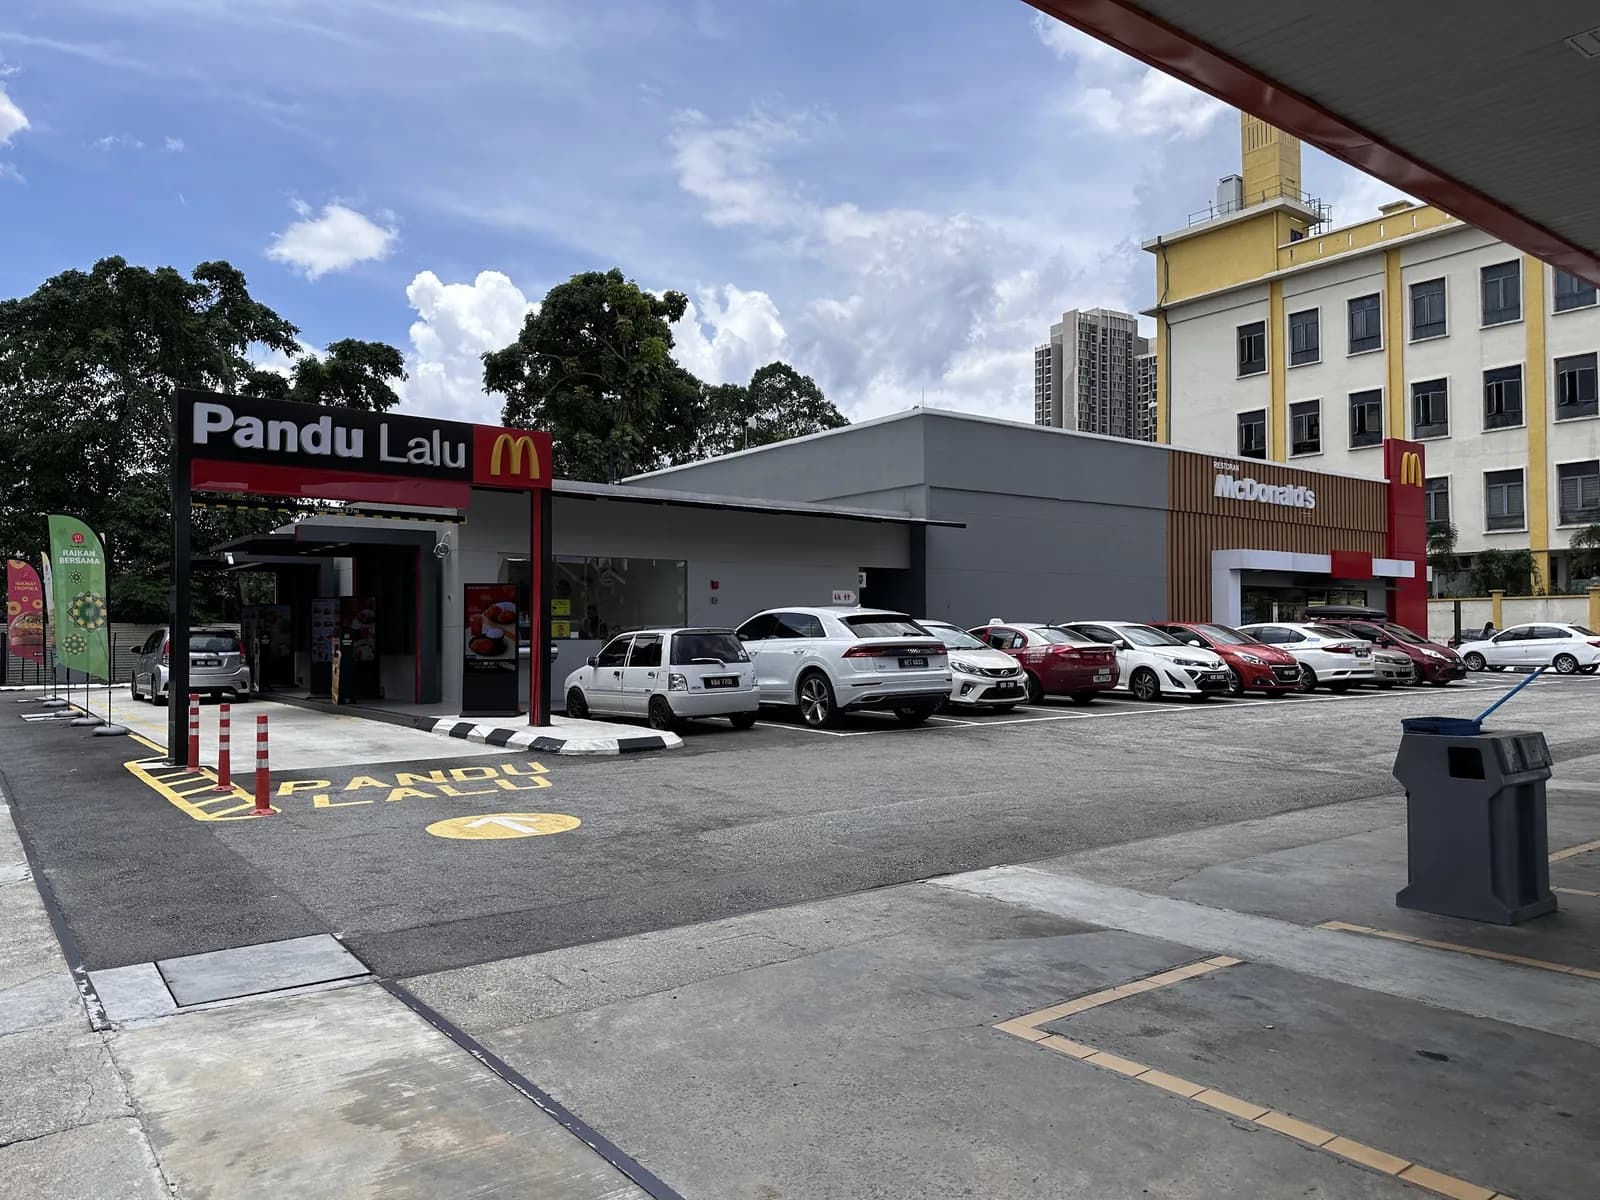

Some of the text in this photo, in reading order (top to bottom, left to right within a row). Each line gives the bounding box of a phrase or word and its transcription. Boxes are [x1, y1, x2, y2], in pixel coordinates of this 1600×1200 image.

[192, 401, 466, 469] Pandu Lalu
[1213, 460, 1240, 472] RESTORAN
[1213, 473, 1316, 509] McDonald's
[58, 556, 101, 565] BERSAMA
[62, 549, 96, 557] RAIKAN
[276, 761, 550, 797] PANDU
[313, 775, 553, 808] LALU
